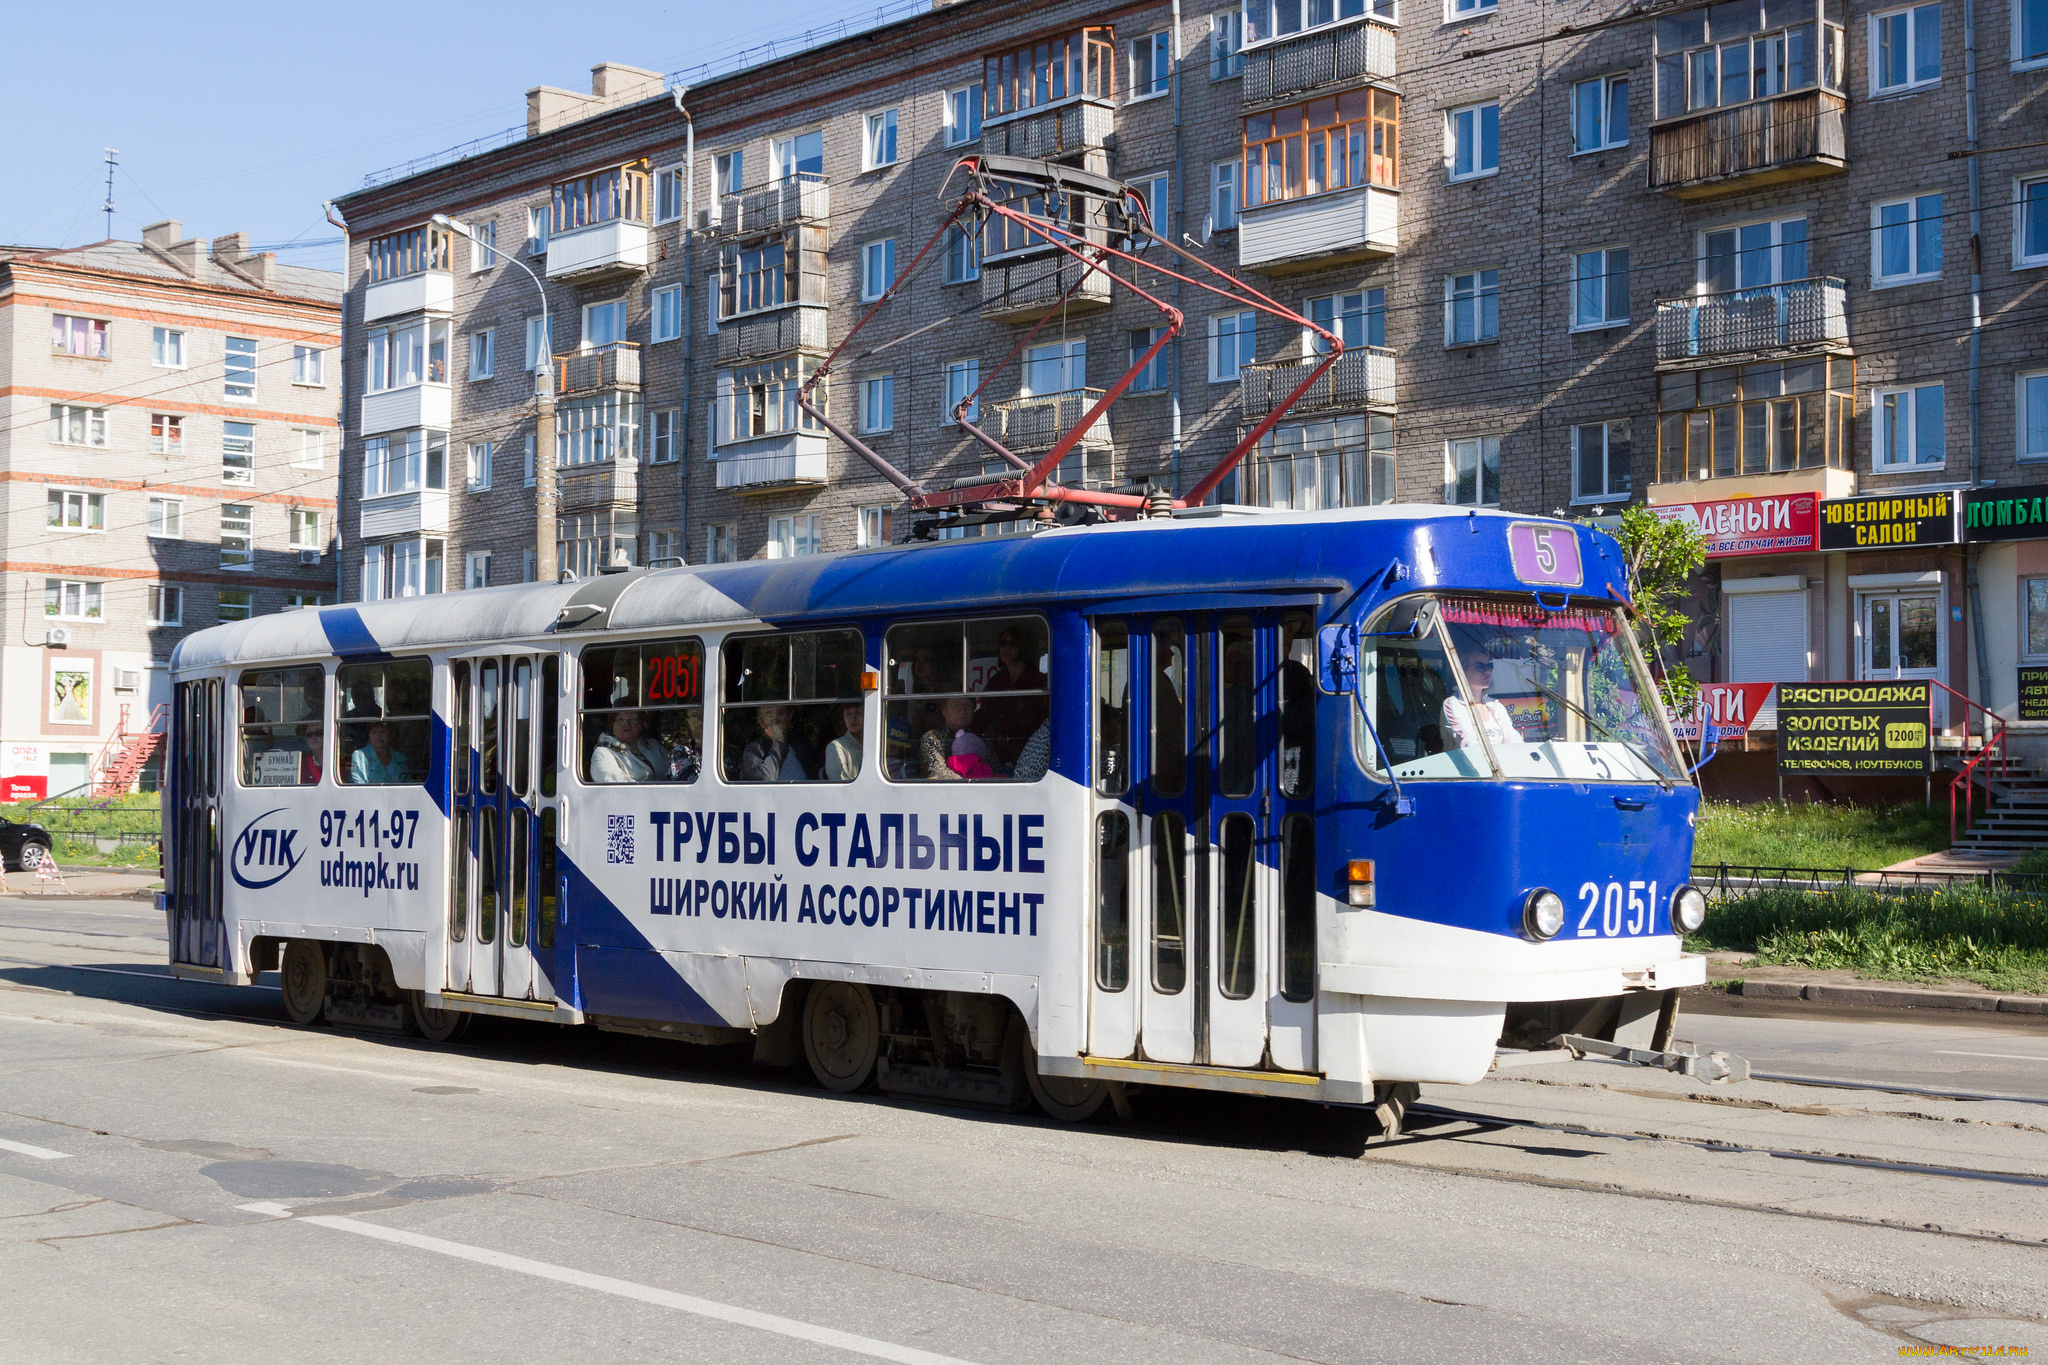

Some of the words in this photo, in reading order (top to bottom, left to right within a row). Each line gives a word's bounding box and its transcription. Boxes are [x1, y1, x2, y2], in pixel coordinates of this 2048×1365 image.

[1700, 499, 1791, 536] ДЕНЬГИ
[1826, 494, 1947, 524] ЮВЕЛИРНЫЙ
[1532, 527, 1557, 574] 5
[1718, 540, 1735, 551] ВСЕ
[1775, 535, 1812, 548] ЖИЗНИ
[1856, 523, 1917, 546] САЛОН
[649, 654, 698, 700] 2051
[1781, 686, 1926, 703] РАСПРОДАЖА
[1786, 715, 1881, 731] ЗОЛОТЫХ
[1888, 730, 1914, 741] 1200
[1787, 732, 1880, 751] ИЗДЕЛИЙ
[254, 756, 262, 784] 5
[1583, 744, 1612, 779] 5
[1784, 759, 1852, 770] ТЕЛЕФОНОВ,
[1855, 759, 1923, 770] НОУТБУКОВ
[320, 809, 420, 849] 97-11-97
[650, 811, 776, 866] ТРУБЫ
[795, 811, 1046, 873] СТАЛЬНЫЕ
[242, 829, 298, 867] УПК
[320, 851, 419, 898] udmpk.ru
[649, 874, 788, 922] ШИРОКИЙ
[797, 883, 1046, 936] АССОРТИМЕНТ
[1577, 880, 1657, 937] 2051
